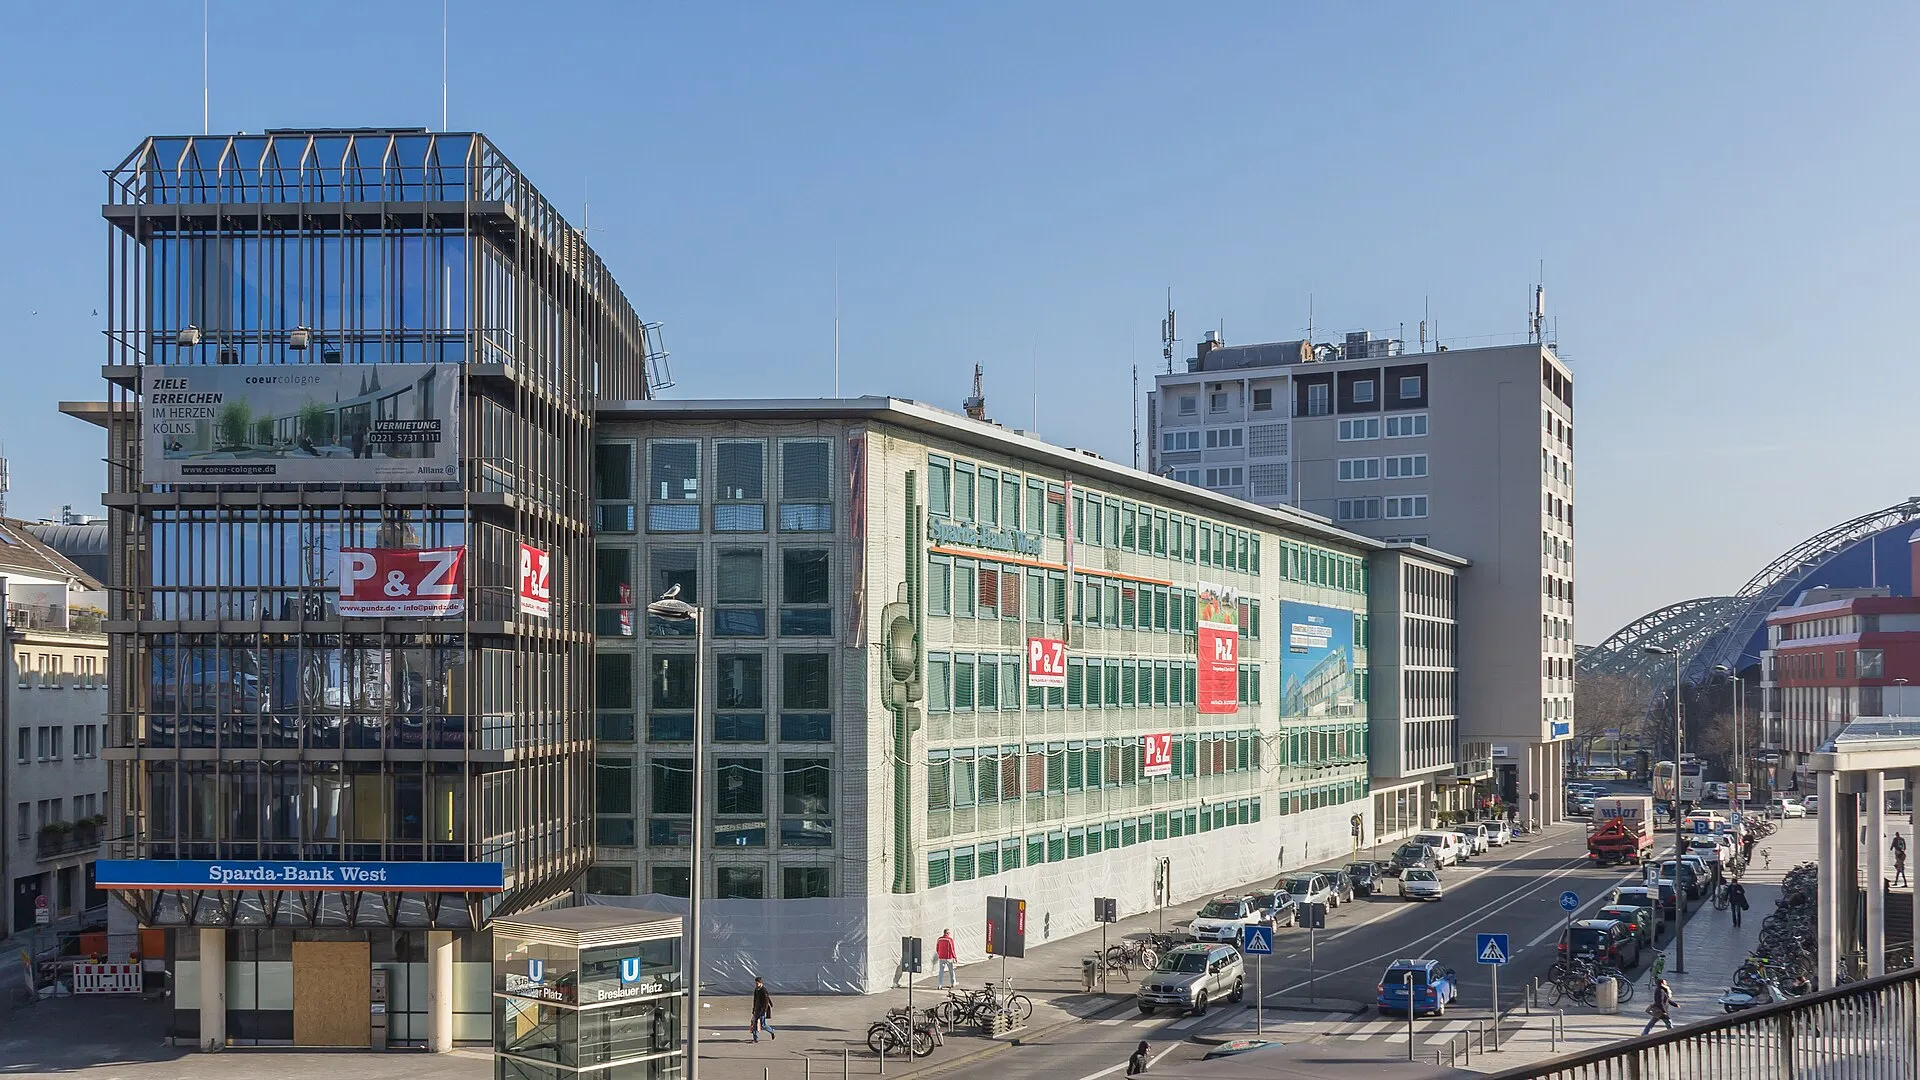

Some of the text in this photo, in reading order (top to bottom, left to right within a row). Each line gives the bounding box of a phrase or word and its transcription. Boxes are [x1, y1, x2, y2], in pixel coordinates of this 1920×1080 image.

[153, 379, 187, 389] ZIELE
[246, 374, 320, 385] coeurcologne
[152, 393, 222, 404] ERREICHEN
[152, 408, 215, 418] IM HERZEN
[153, 420, 194, 434] KÖLNS.
[377, 421, 440, 430] VERMIETUNG:
[371, 434, 440, 442] 0221. 5731 1111
[183, 466, 275, 474] www.coeur-cologne.de
[417, 466, 444, 474] Allianz
[340, 603, 459, 613] www.pundz.de info@pundz.de
[209, 866, 386, 883] Sparda-Bank West
[529, 959, 543, 982] U
[623, 959, 640, 982] U
[543, 987, 563, 1001] Platz
[598, 983, 663, 1000] Breslauer Platz
